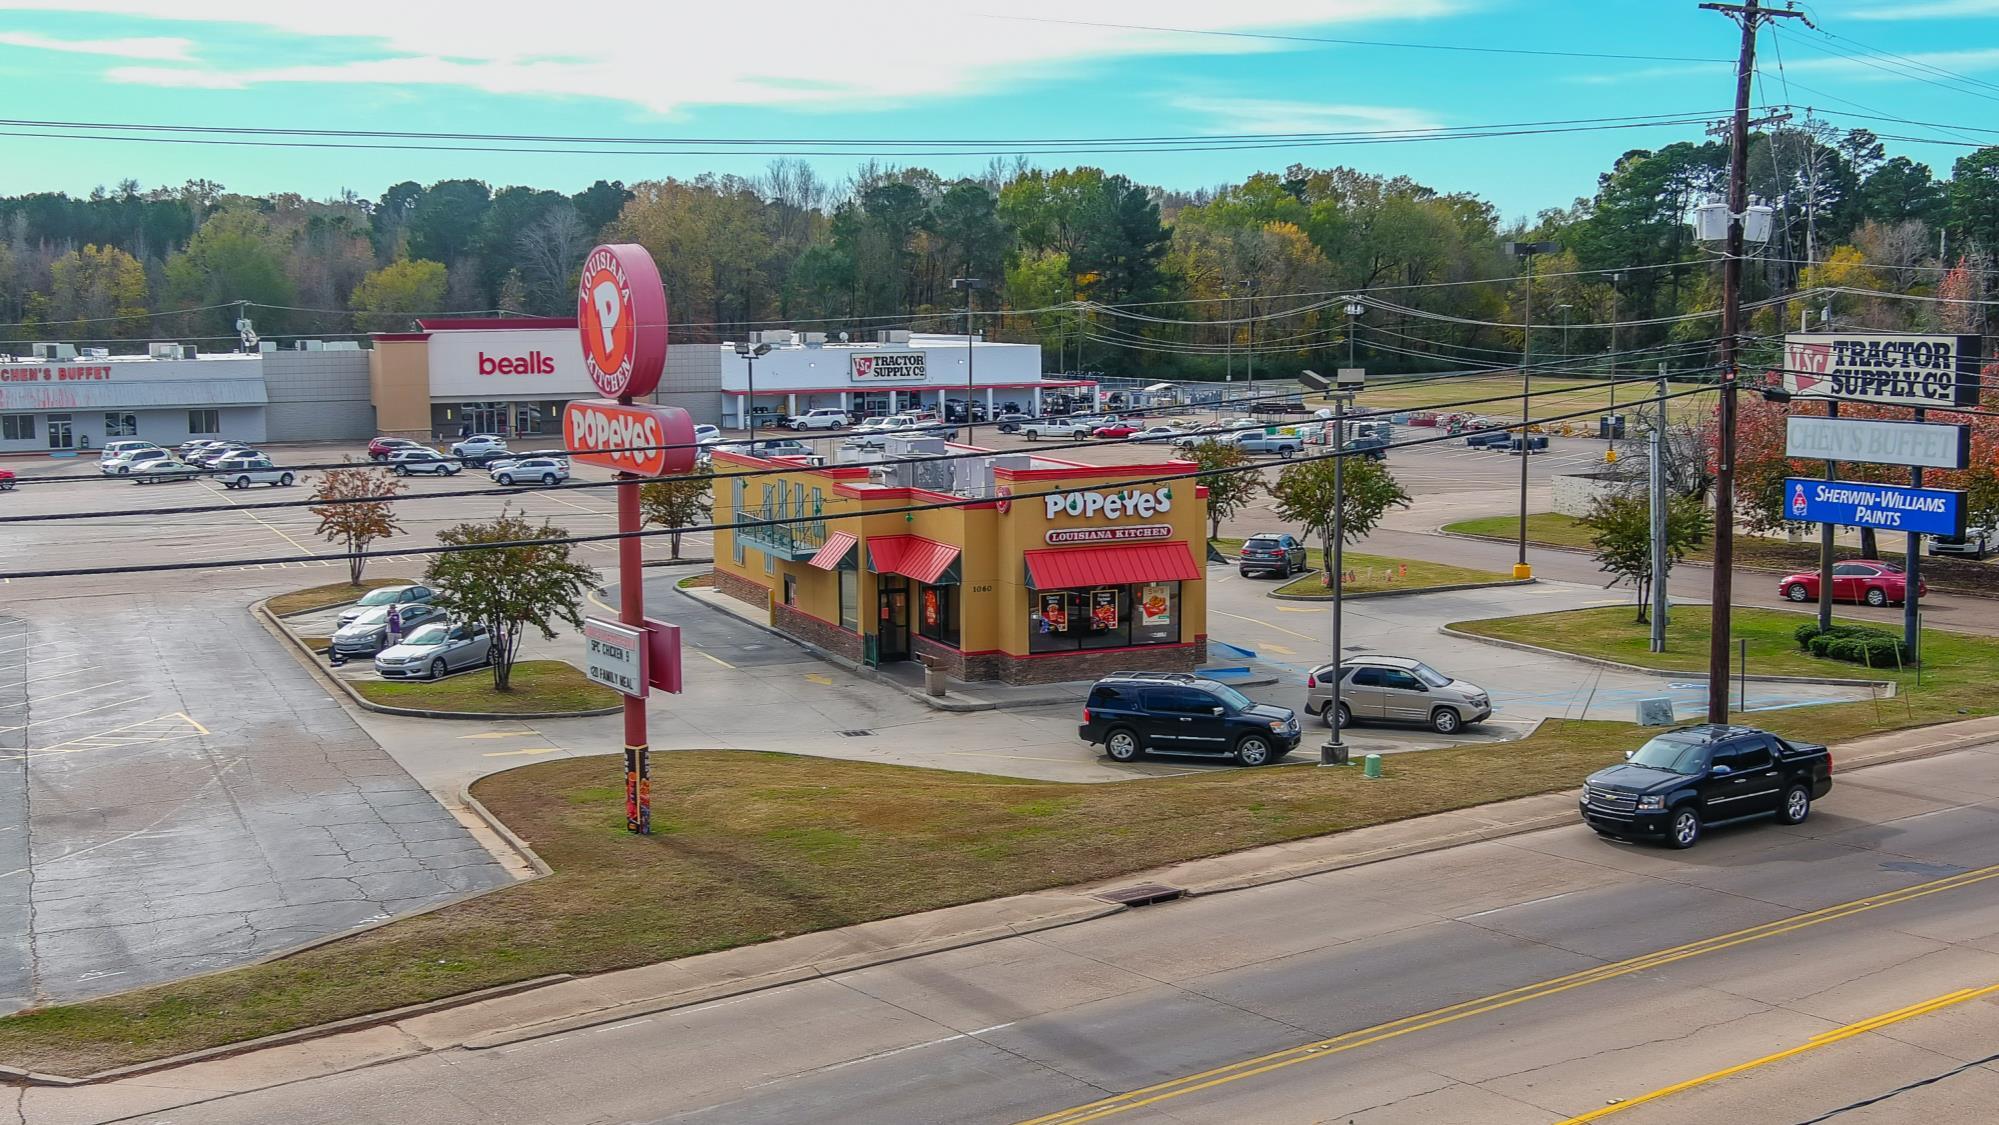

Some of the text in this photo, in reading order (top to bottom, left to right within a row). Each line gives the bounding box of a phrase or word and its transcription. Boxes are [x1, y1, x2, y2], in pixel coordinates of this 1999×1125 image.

[580, 251, 630, 306] LOUISIANA
[478, 351, 555, 375] bealls
[873, 355, 924, 366] TRACTOR
[1833, 340, 1952, 370] TRACTOR
[0, 366, 111, 381] CHEN'S BUFFET
[586, 351, 632, 393] KITCHEN
[854, 358, 871, 373] TSC
[873, 366, 912, 377] SUPPLY
[1830, 368, 1920, 398] SUPPLY
[1869, 427, 1955, 460] BUFFET
[1855, 506, 1901, 526] PAINTS
[1052, 527, 1168, 541] LOUISIANA KITCHEN
[973, 585, 992, 593] 1060
